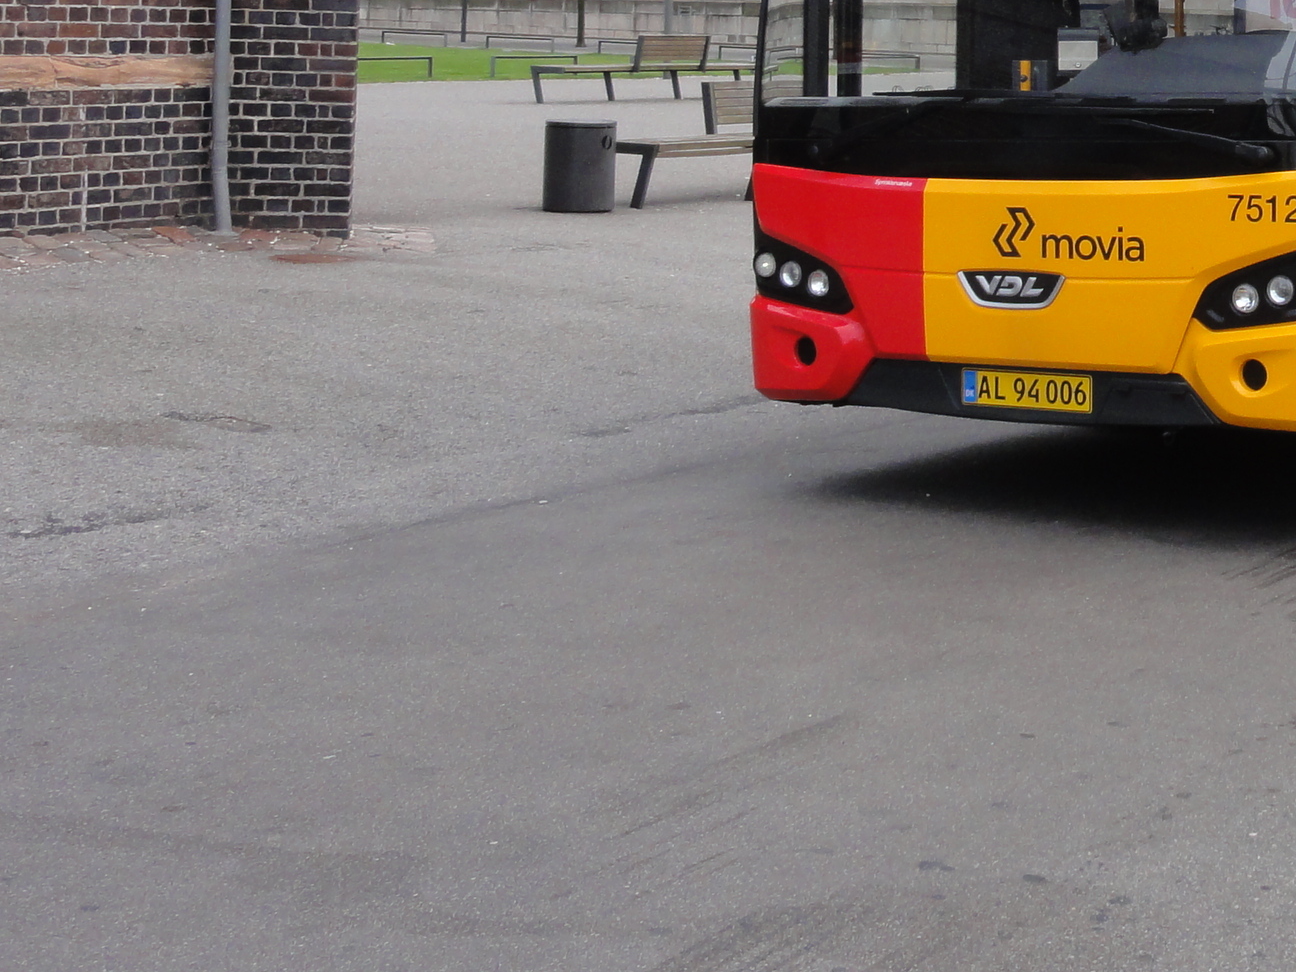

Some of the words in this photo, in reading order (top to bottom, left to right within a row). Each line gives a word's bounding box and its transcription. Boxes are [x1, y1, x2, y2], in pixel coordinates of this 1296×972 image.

[1041, 226, 1145, 262] movia
[974, 275, 1045, 298] VDL
[978, 375, 1006, 401] AL
[1013, 377, 1040, 403] 94
[1045, 379, 1087, 406] 006
